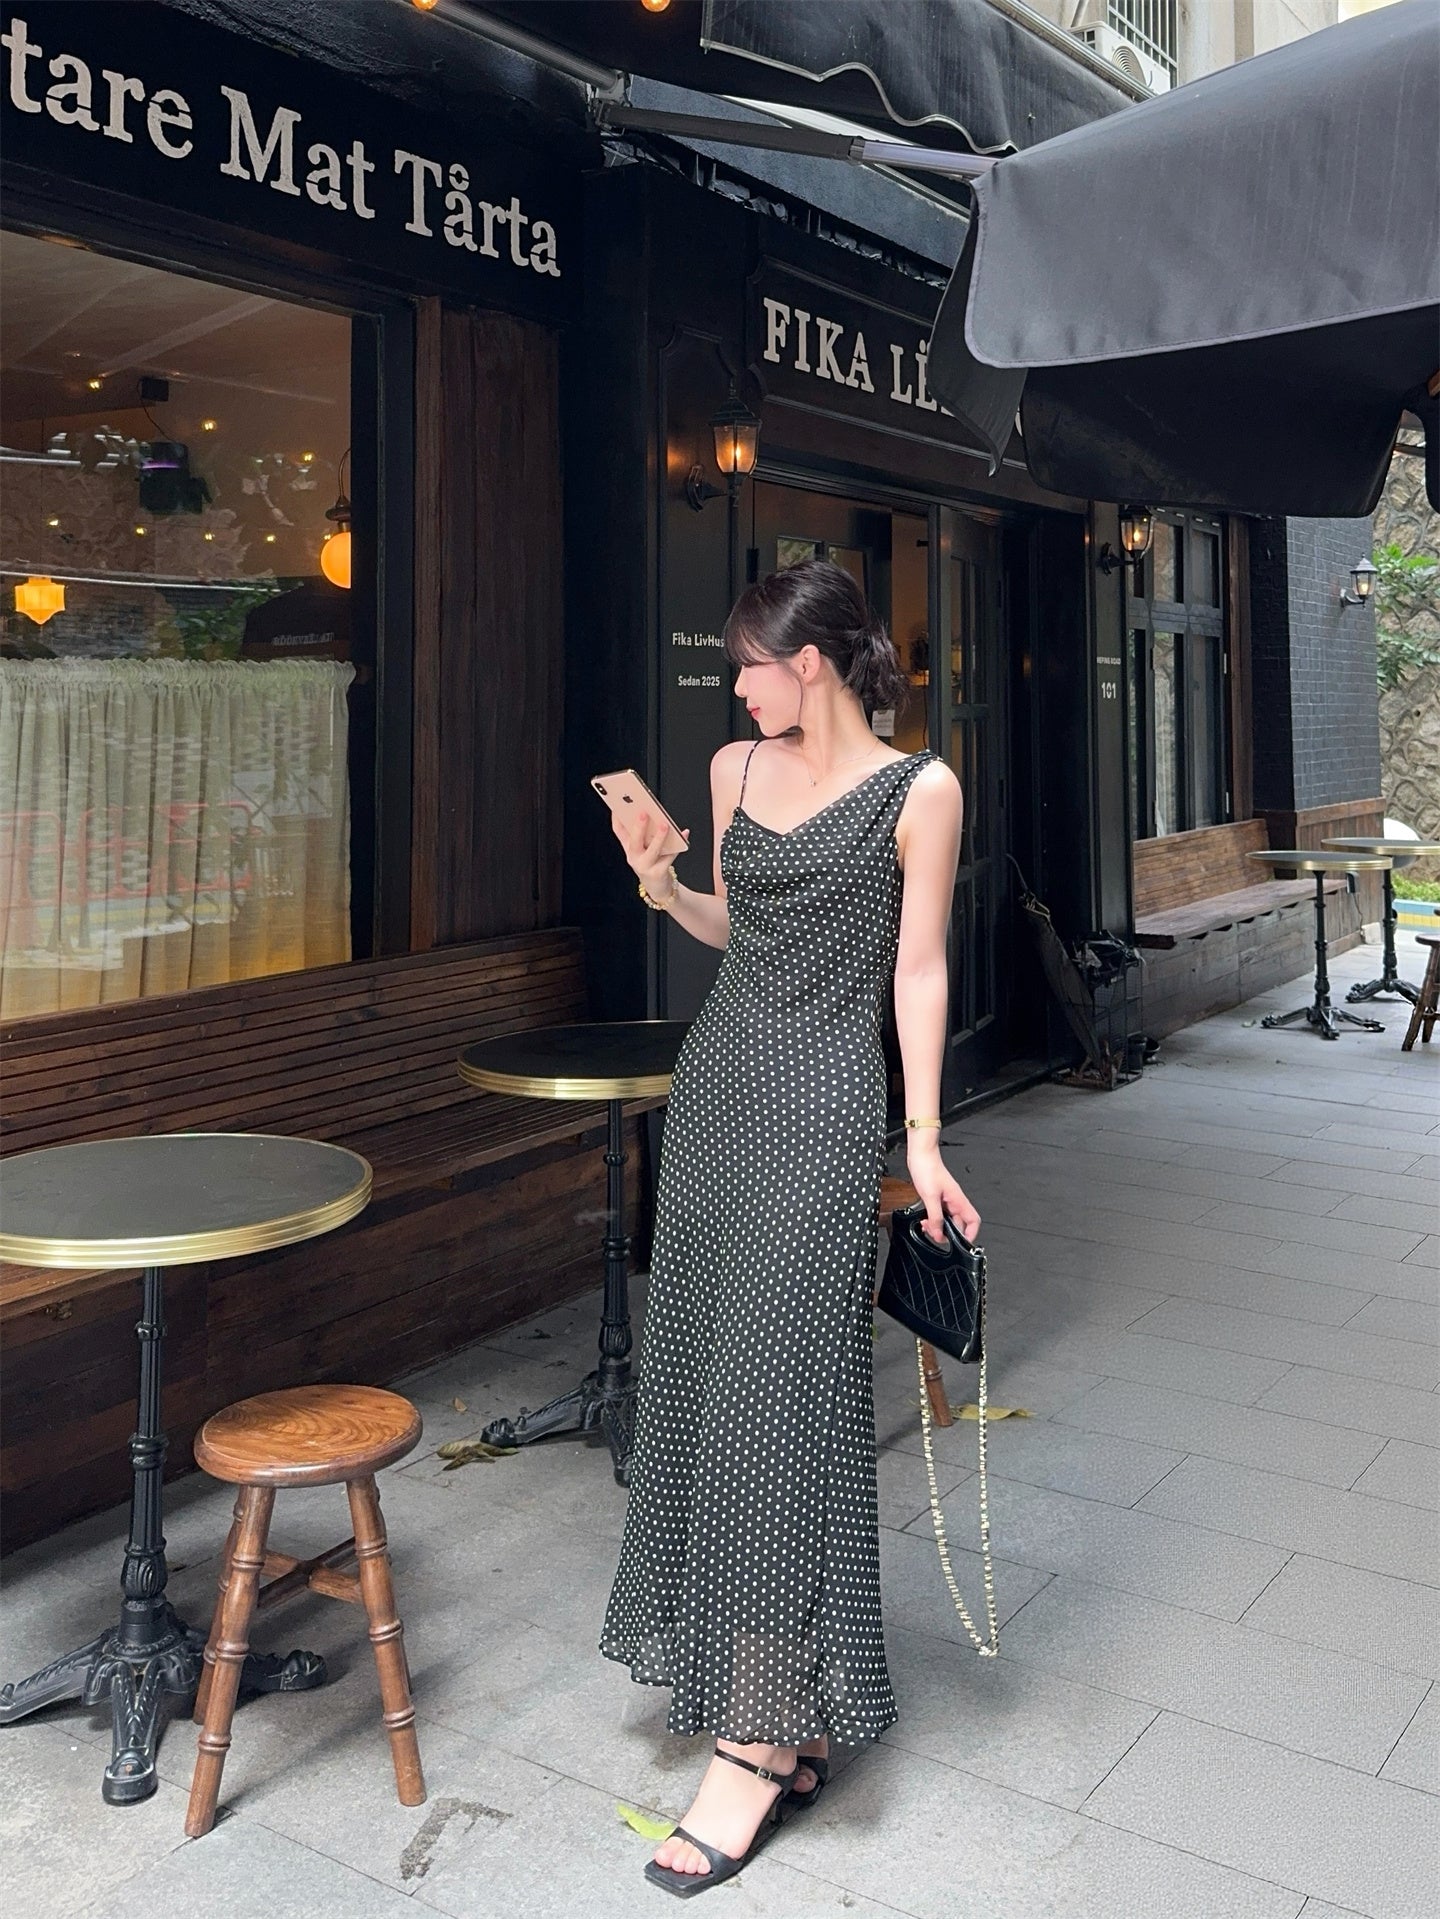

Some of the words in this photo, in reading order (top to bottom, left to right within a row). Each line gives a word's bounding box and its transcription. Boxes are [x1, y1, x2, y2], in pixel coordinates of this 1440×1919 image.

[220, 86, 375, 219] Mat
[394, 150, 561, 277] Tårta
[763, 297, 875, 393] FIKA
[672, 632, 692, 646] Fika
[678, 675, 700, 686] Sedan
[701, 675, 720, 687] 2025
[1101, 682, 1116, 699] 101
